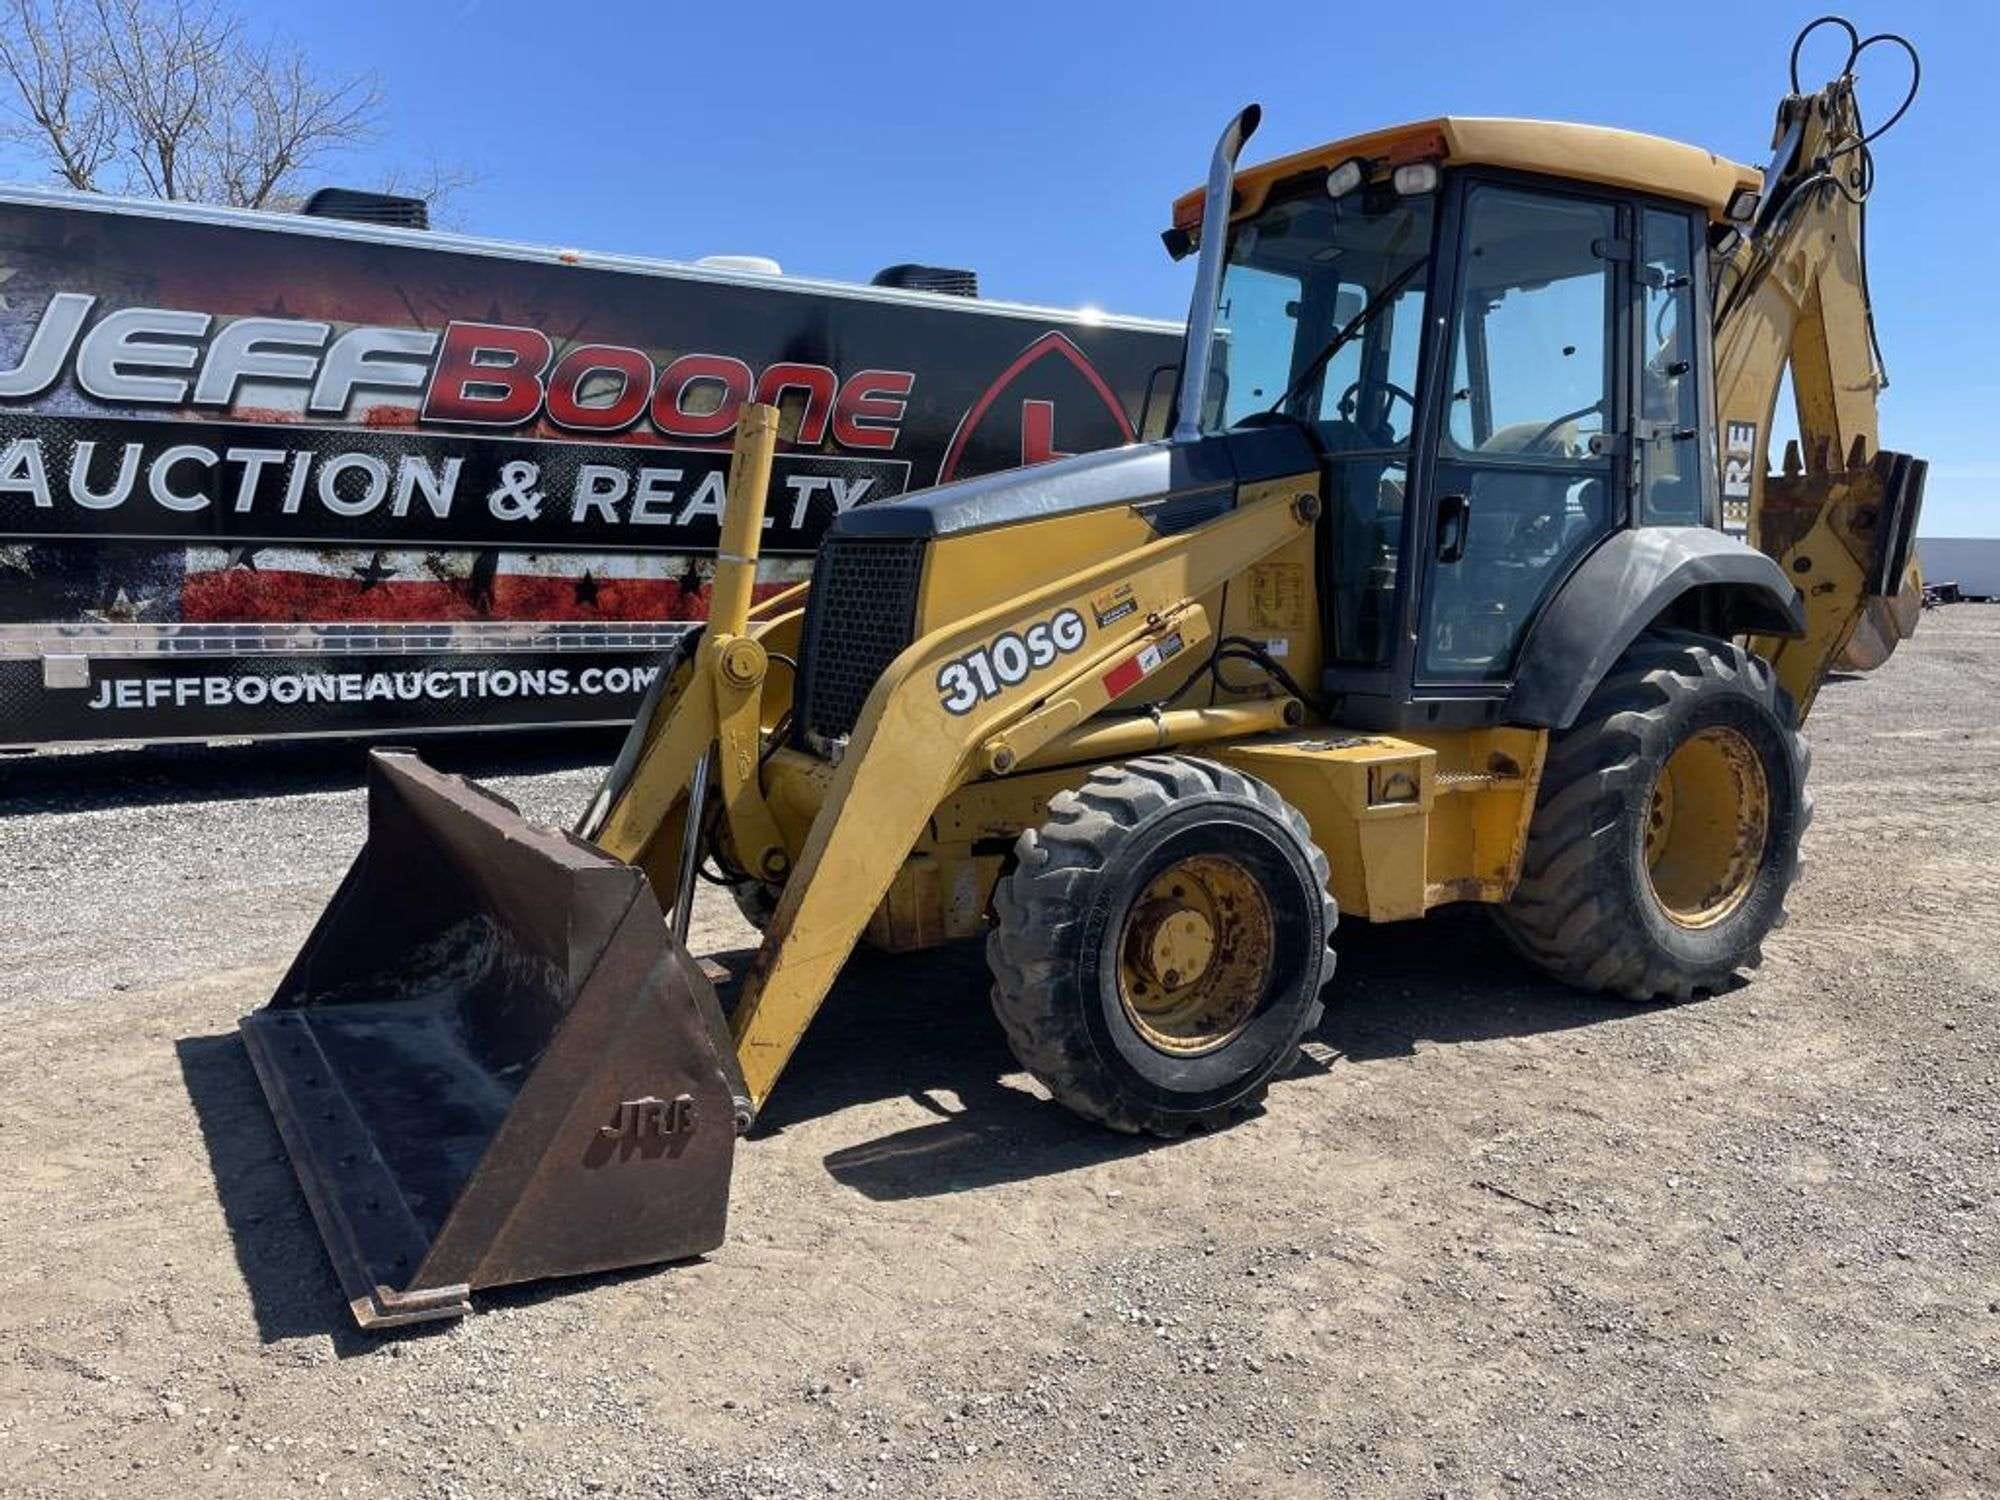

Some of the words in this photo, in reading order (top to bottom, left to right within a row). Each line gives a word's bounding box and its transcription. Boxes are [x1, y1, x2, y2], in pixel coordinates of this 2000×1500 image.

[0, 438, 464, 518] AUCTION
[488, 461, 543, 521] &
[570, 463, 875, 530] REATY
[1722, 423, 1756, 541] ERE
[88, 667, 660, 709] JEFFBOONEAUCTIONS.COM
[937, 609, 1085, 715] 310SG
